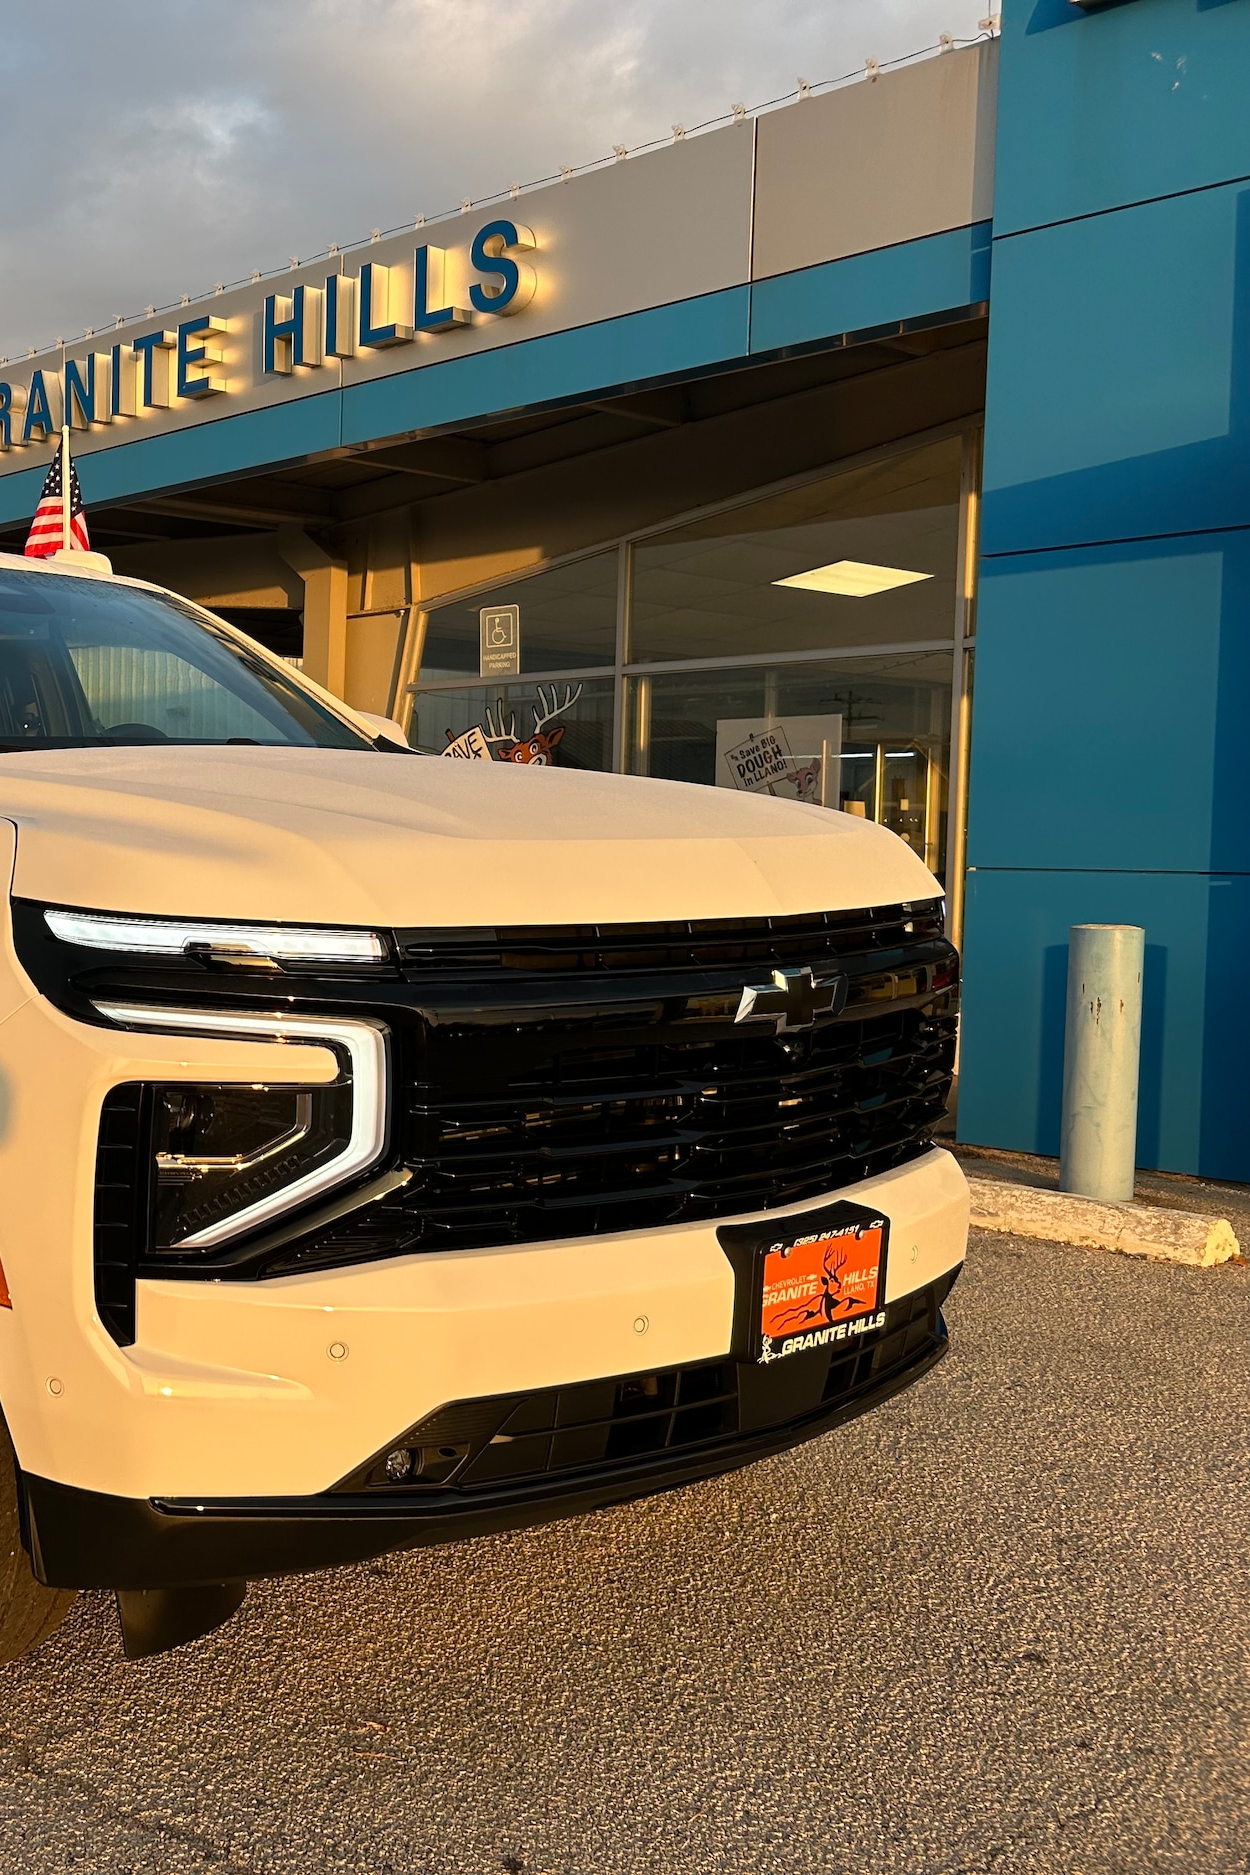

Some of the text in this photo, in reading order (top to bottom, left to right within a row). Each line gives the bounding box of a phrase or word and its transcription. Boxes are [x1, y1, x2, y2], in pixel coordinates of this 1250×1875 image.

[263, 219, 532, 376] HILLS
[482, 652, 517, 661] HANDICAPPED
[488, 661, 511, 669] PARKING
[739, 735, 776, 760] Save BIG
[736, 744, 783, 778] DOUGH
[743, 759, 788, 787] in LLANO!
[771, 1275, 807, 1290] CHEVROLET
[842, 1266, 878, 1286] HILLS
[843, 1280, 875, 1295] LLANO, TX
[781, 1312, 886, 1355] GRANITE HILLS
